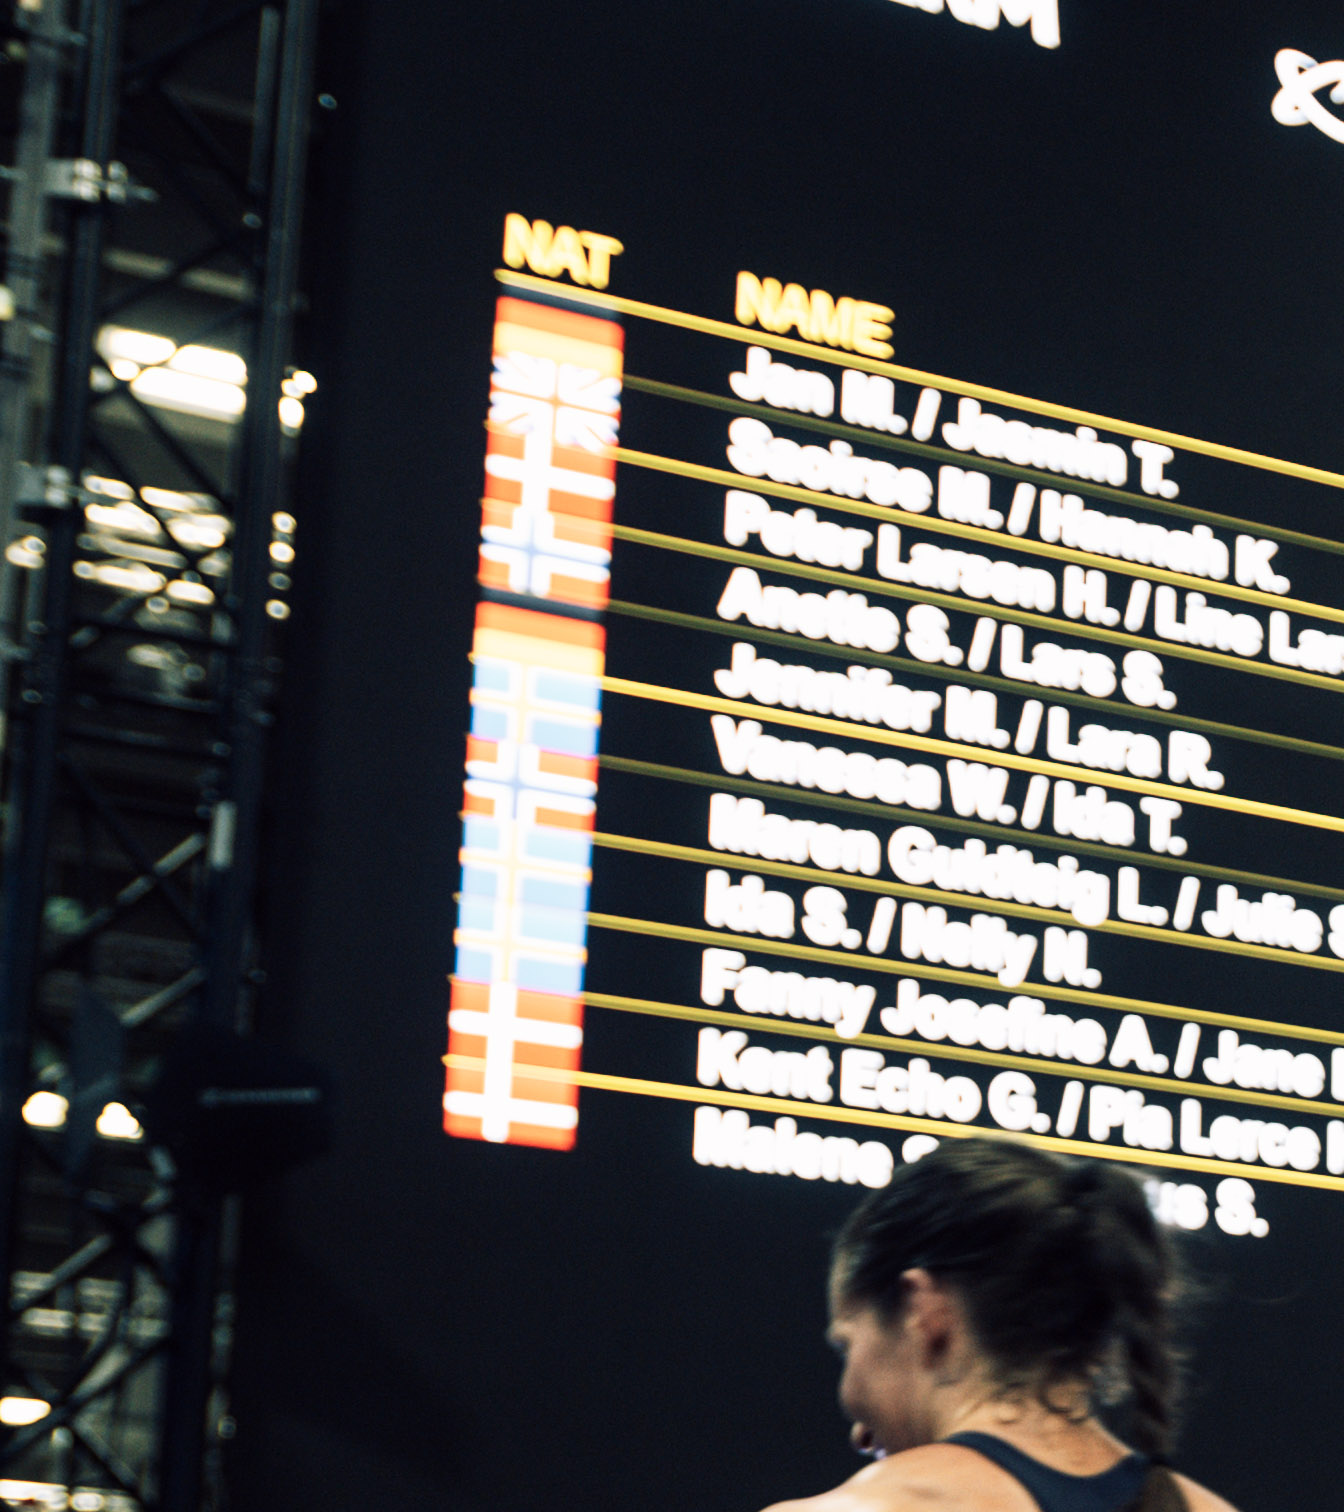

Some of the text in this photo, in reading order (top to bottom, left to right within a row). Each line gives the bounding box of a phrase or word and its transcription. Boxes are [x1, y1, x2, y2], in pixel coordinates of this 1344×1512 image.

[502, 212, 625, 290] NAT
[734, 270, 896, 359] NAME
[1131, 439, 1179, 499] T.
[724, 489, 873, 571] Peter
[877, 523, 1056, 613] Larsen
[1062, 564, 1120, 627] H.
[1154, 585, 1264, 657] Line
[1039, 489, 1229, 581] Hannah
[1234, 534, 1291, 595] K.
[904, 604, 964, 666] S.
[1000, 623, 1117, 698] Lars
[1121, 649, 1177, 710] S.
[711, 714, 942, 811] Vanessa
[946, 758, 1017, 825] W.
[1053, 779, 1135, 847] Ida
[1139, 796, 1188, 856] T.
[1167, 730, 1224, 791] R.
[704, 869, 795, 939] Ida
[801, 885, 862, 949] S.
[1043, 926, 1102, 989] N.
[1117, 866, 1169, 926] L.
[1201, 884, 1324, 953] Julie
[700, 947, 876, 1040] Fanny
[1108, 1014, 1169, 1074] A.
[697, 1027, 834, 1103] Kent
[839, 1047, 982, 1123] Echo
[987, 1070, 1051, 1133] G.
[1088, 1084, 1173, 1151] Pia
[693, 1105, 894, 1189] Malene
[1214, 1177, 1269, 1238] S.
